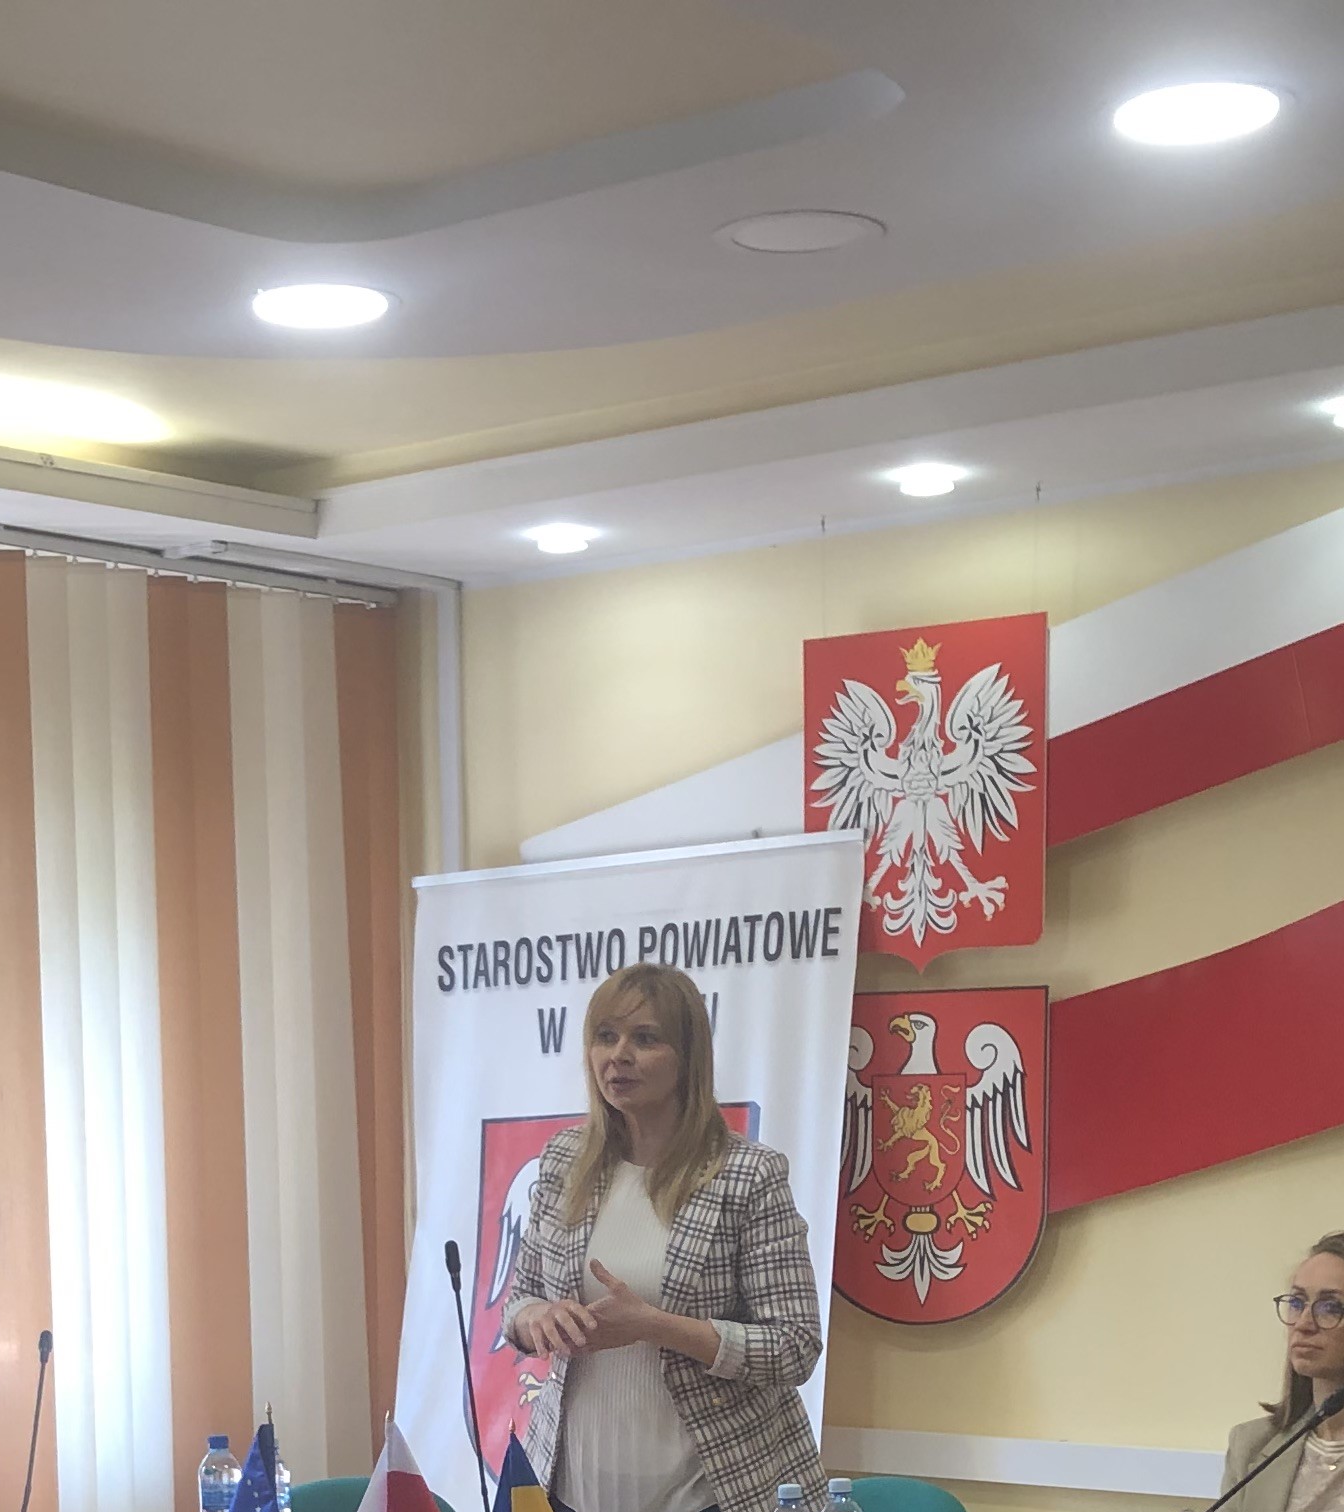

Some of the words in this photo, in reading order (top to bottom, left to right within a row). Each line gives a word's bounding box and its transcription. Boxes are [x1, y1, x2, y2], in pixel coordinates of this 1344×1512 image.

[437, 928, 625, 993] STAROSTWO
[638, 906, 842, 968] POWIATOWE
[537, 1006, 567, 1055] W
